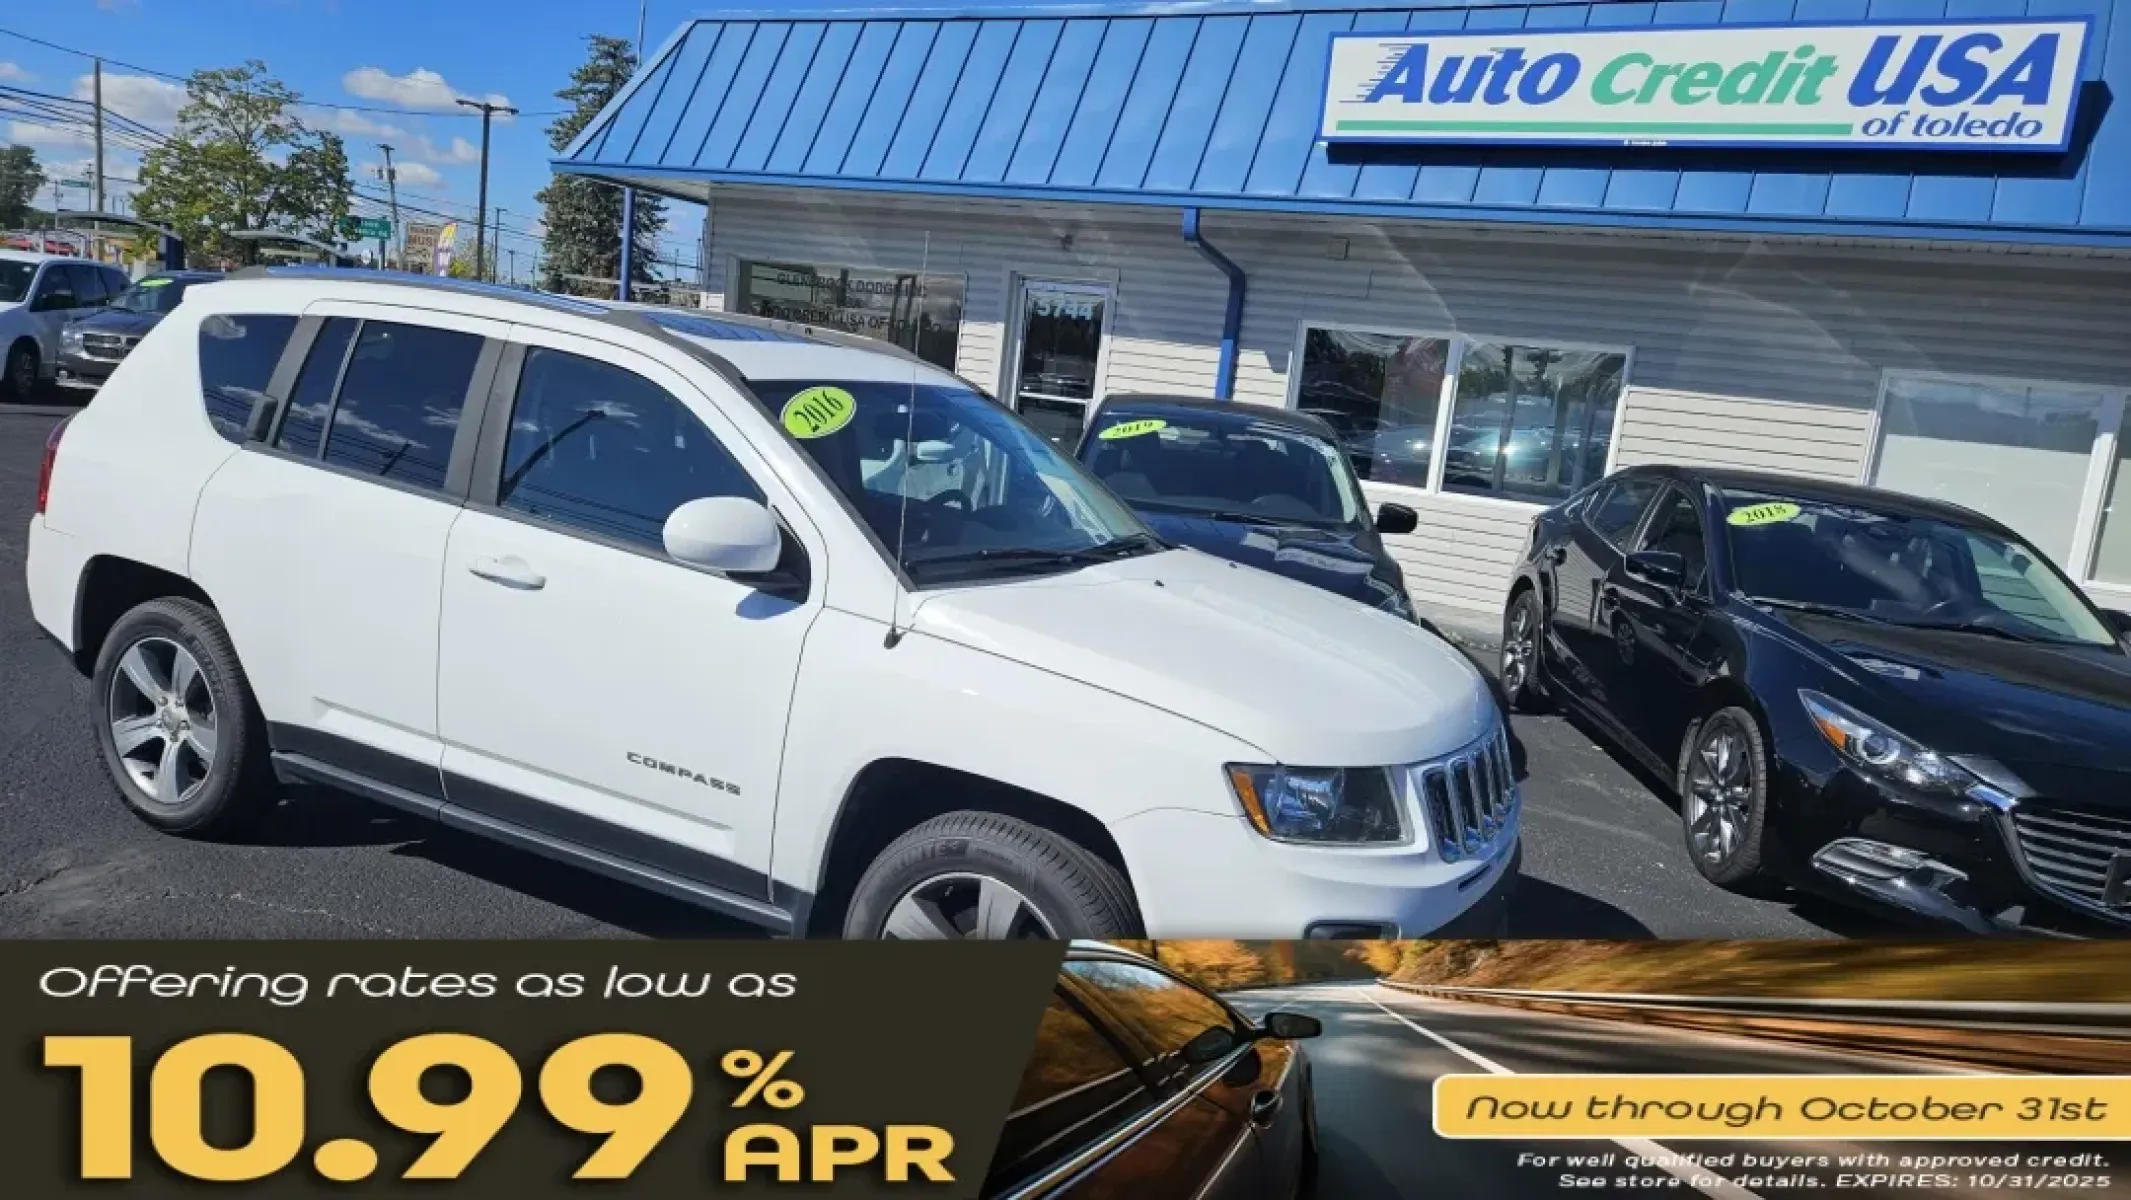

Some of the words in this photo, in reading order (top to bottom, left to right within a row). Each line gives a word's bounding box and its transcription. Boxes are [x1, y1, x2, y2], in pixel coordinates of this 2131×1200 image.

[1362, 43, 1582, 106] Auto
[1590, 45, 1839, 106] Credit
[1847, 32, 2061, 107] USA
[1861, 110, 1909, 138] of
[1912, 111, 2043, 139] toledo
[793, 388, 844, 433] 2016
[1745, 504, 1787, 524] 2018
[626, 751, 741, 796] COMPASS
